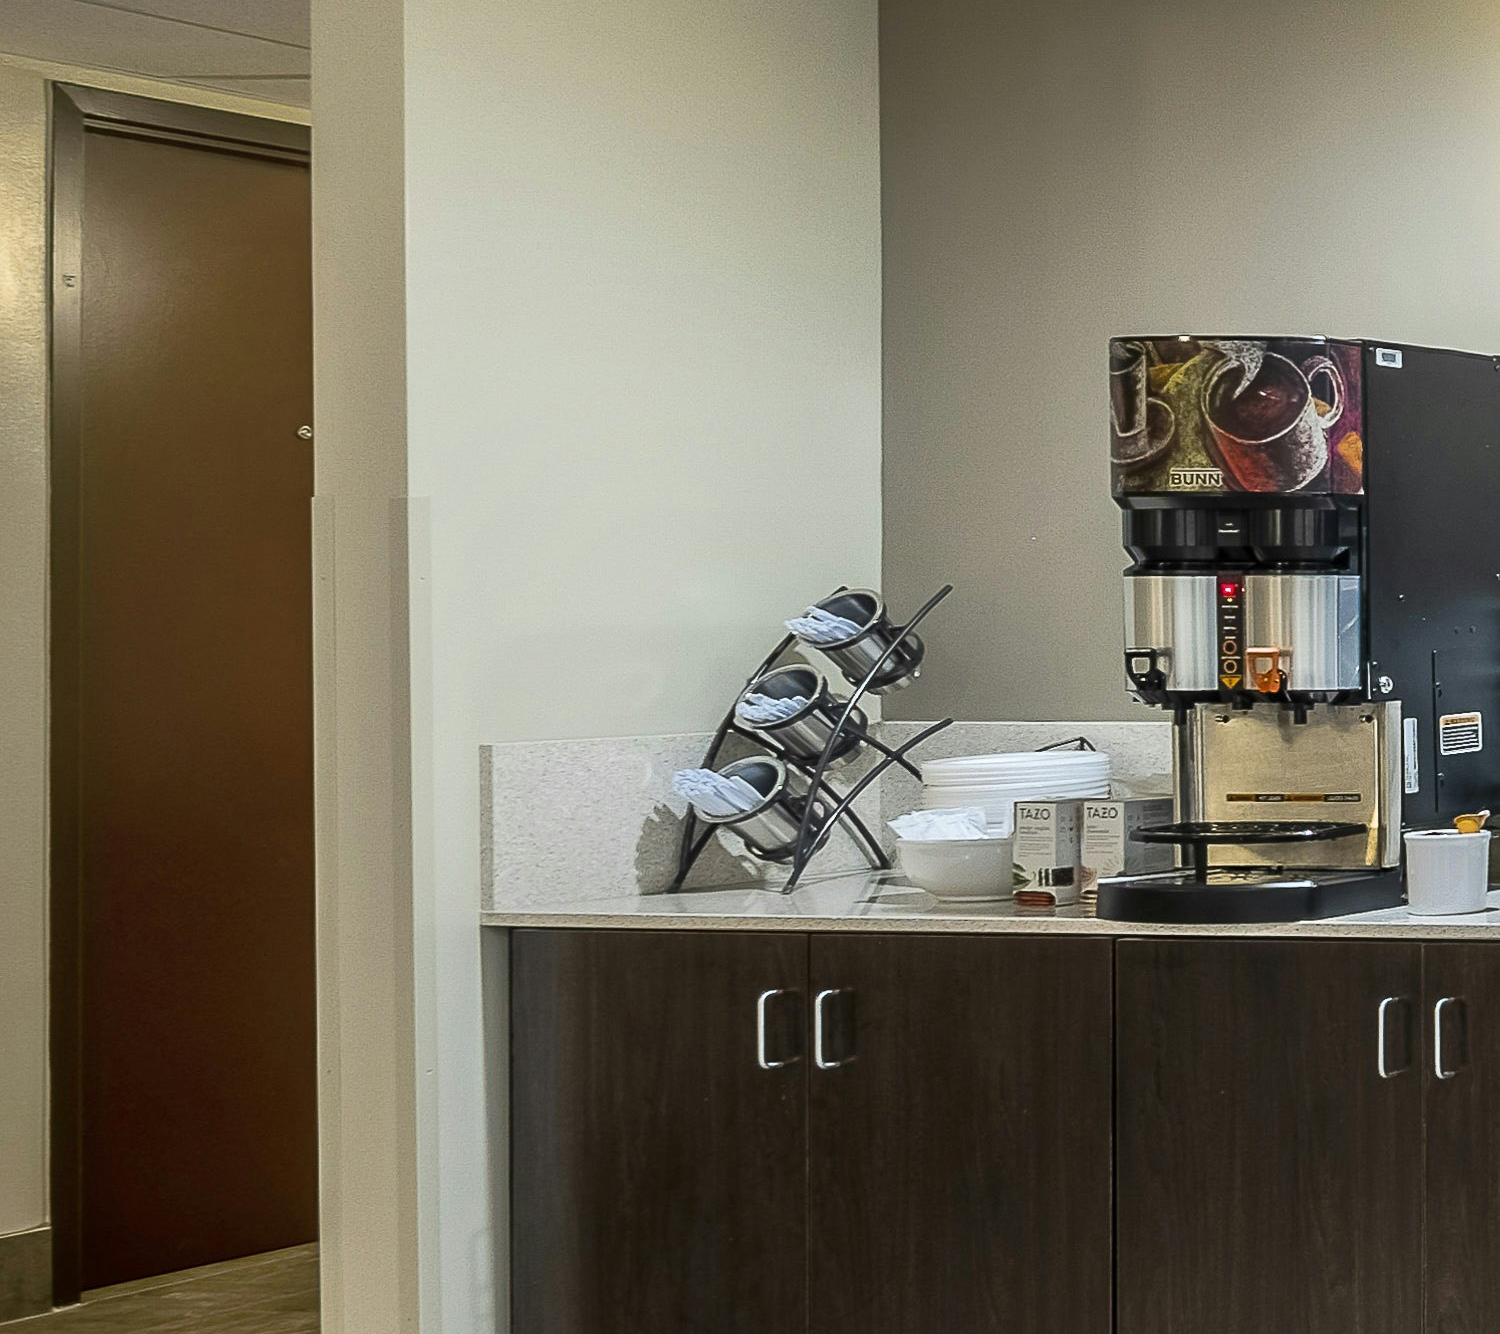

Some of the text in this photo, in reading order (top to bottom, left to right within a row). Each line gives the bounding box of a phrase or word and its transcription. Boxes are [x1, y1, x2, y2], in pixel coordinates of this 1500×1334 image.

[1169, 473, 1222, 486] BUNN
[1019, 807, 1051, 821] TAZO
[1086, 807, 1119, 819] TAZO
